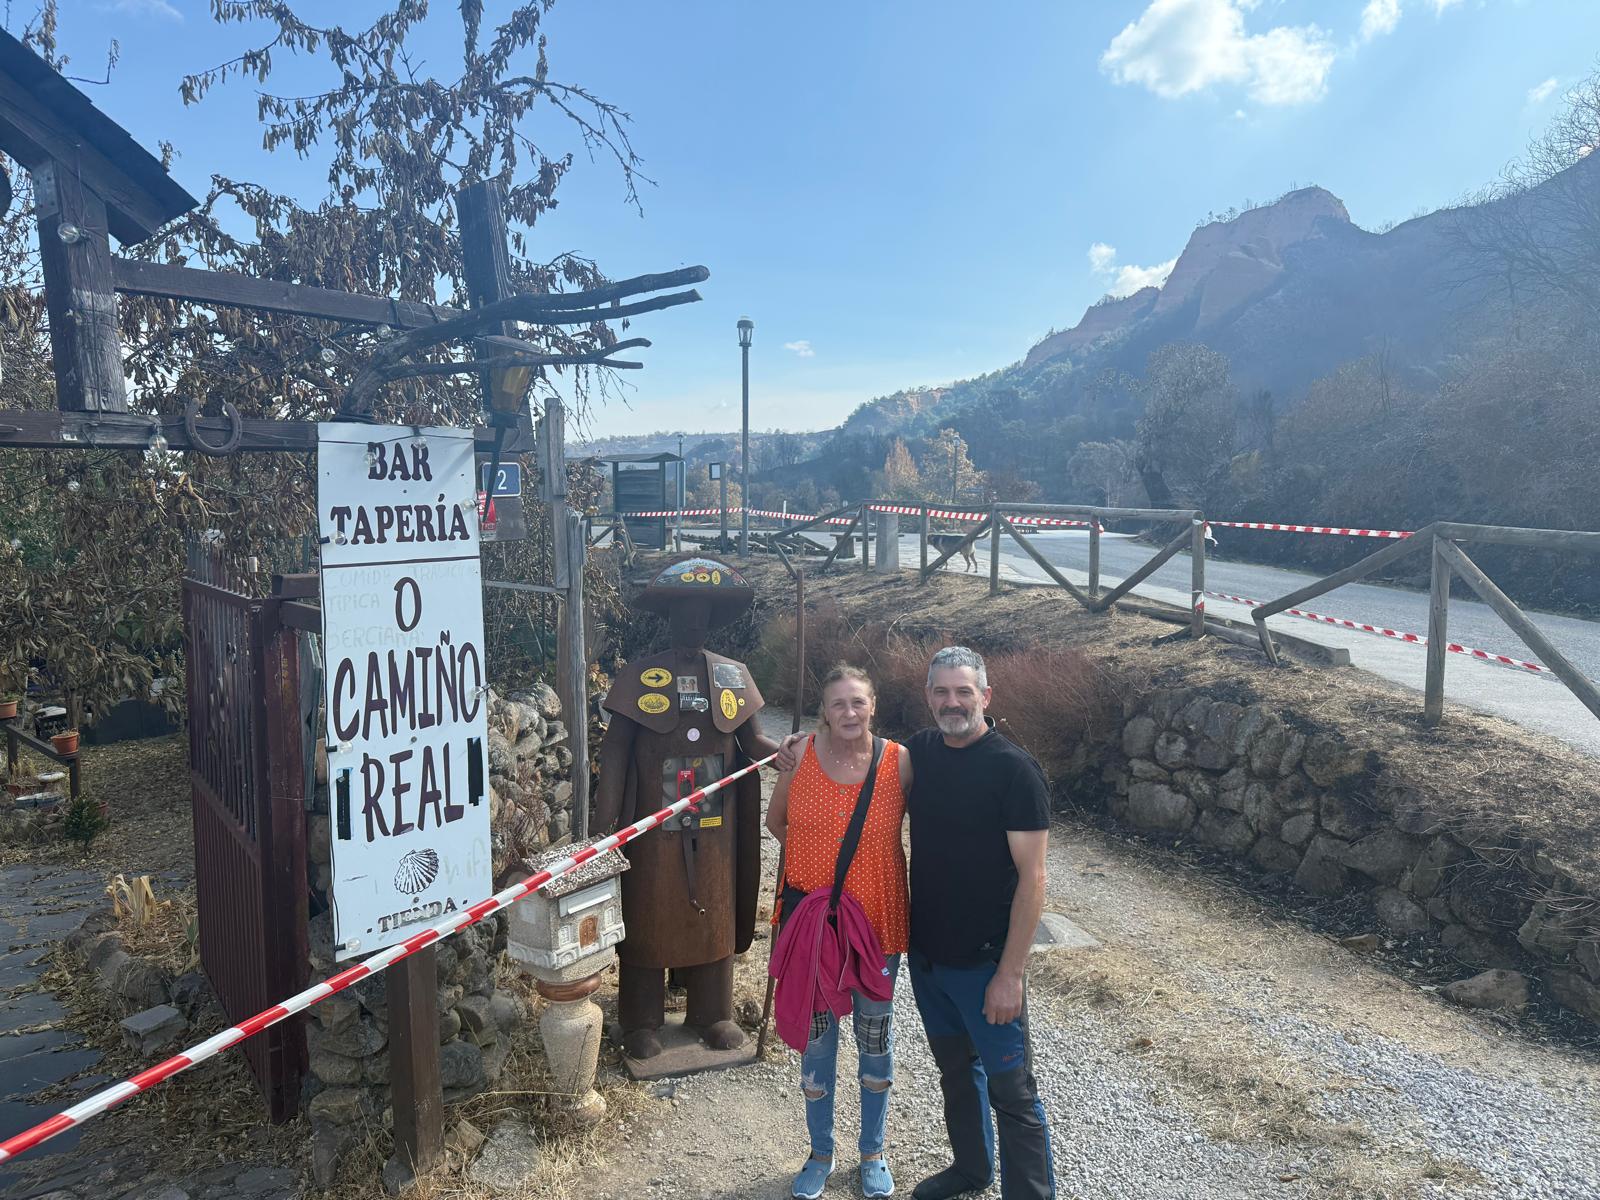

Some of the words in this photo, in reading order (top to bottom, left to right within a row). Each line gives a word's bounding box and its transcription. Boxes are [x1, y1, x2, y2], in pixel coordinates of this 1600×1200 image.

[367, 442, 433, 482] BAR
[497, 470, 508, 491] 2
[330, 493, 470, 544] TAPERÍA
[393, 576, 423, 633] O
[333, 630, 482, 741] CAMIÑO
[360, 742, 465, 842] REAL
